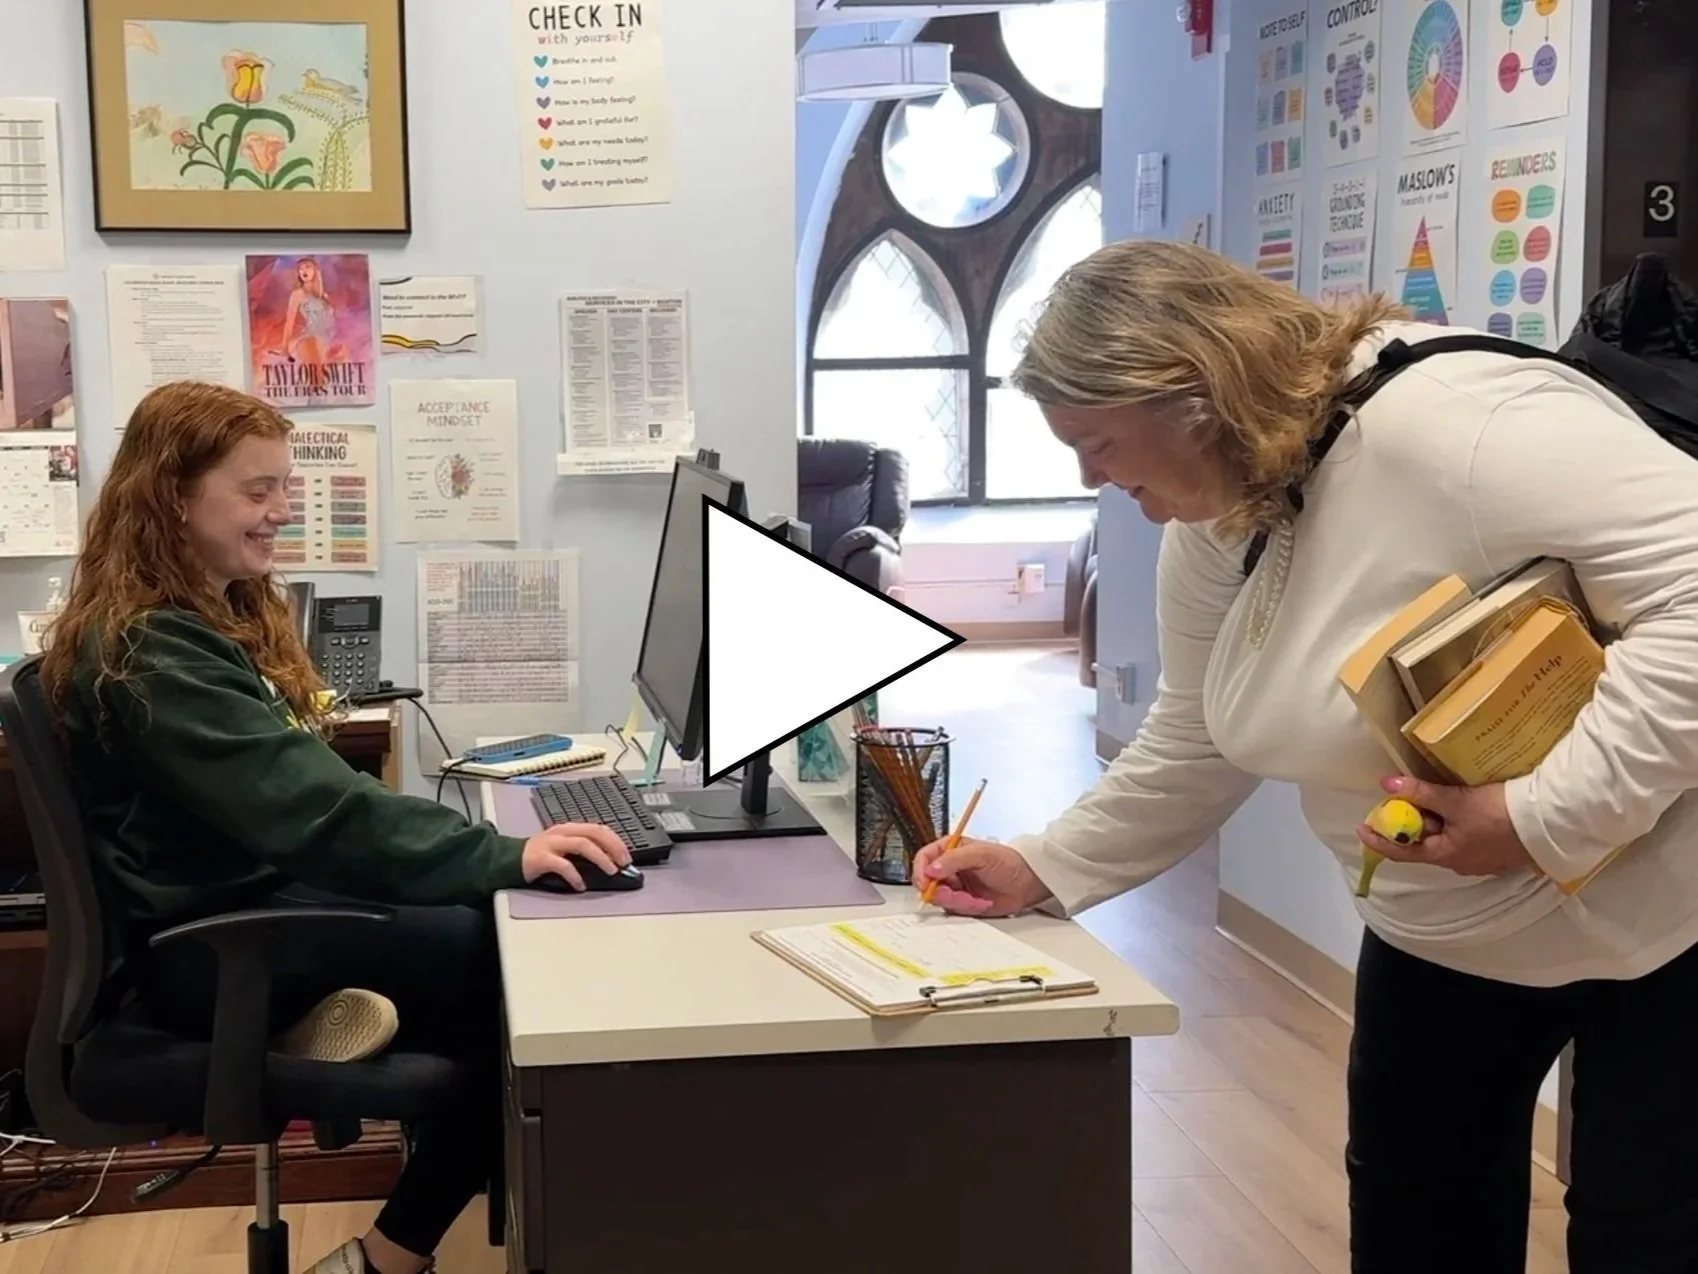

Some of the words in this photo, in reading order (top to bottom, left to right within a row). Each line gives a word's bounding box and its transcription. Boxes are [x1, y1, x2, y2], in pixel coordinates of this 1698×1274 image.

[529, 5, 602, 30] CHECK
[614, 3, 642, 27] IN
[1288, 10, 1305, 30] SELF
[538, 33, 568, 44] with
[575, 30, 634, 45] yourself
[590, 56, 603, 64] and
[556, 118, 575, 126] What
[1491, 151, 1556, 180] REMINDERS
[560, 180, 579, 188] What
[1397, 163, 1456, 194] MASLOW'S
[1258, 192, 1295, 215] ANXIETY
[1648, 184, 1675, 222] 3
[262, 363, 318, 386] TAYLOR
[321, 361, 365, 385] SWIFT
[264, 386, 289, 397] THE
[294, 385, 328, 397] ERAS
[331, 384, 366, 396] TOUR
[417, 401, 490, 414] ACCEPTANCE
[426, 415, 482, 427] MINDSET
[290, 431, 350, 445] IALECTICAL
[290, 445, 347, 460] HINKING
[1504, 699, 1520, 717] FOR
[1521, 681, 1535, 699] The
[1533, 655, 1562, 681] Help
